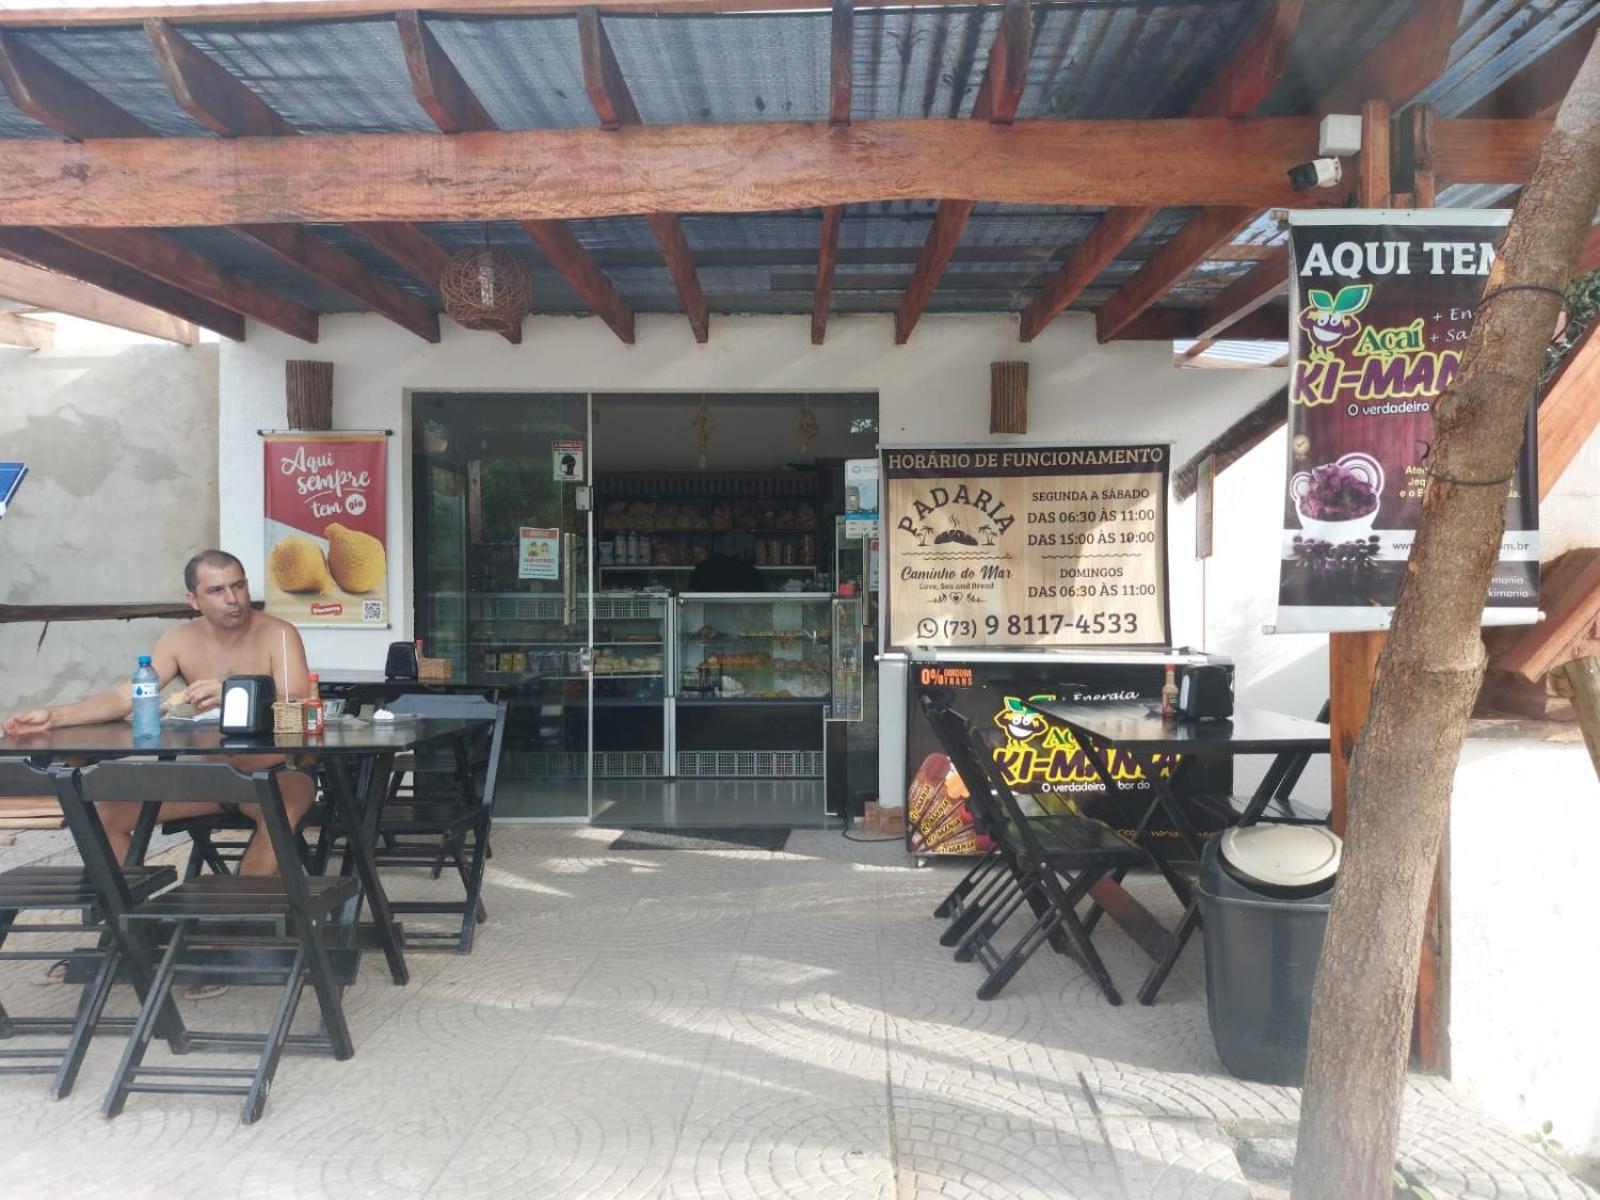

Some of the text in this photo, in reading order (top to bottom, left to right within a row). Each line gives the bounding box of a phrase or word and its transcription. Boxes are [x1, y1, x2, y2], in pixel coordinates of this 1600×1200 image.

[1300, 241, 1411, 279] AQUI
[1352, 319, 1425, 356] Açaí
[1292, 350, 1464, 407] KI-MAN
[1347, 401, 1430, 416] O verdadeiro
[281, 446, 335, 475] Aqui
[888, 451, 970, 470] HORÁRIO
[974, 453, 998, 468] DE
[1002, 448, 1163, 467] FUNCIONAMENTO
[296, 469, 371, 497] sempre
[1032, 488, 1150, 502] SEGUNDA A SÁBADO
[310, 501, 342, 518] tem
[898, 484, 1015, 536] PADARIA
[1027, 507, 1155, 524] DAS 06:30 ÀS 11:00
[1028, 534, 1057, 546] DAS
[1060, 533, 1095, 545] 15:00
[1098, 529, 1117, 544] ÀS
[901, 564, 1013, 580] Caminho do Mar
[1060, 567, 1124, 578] DOMINGOS
[1028, 582, 1156, 598] DAS 06:30 ÀS 11:00
[943, 611, 1139, 639] (73) 9 8117-4533
[921, 668, 944, 686] 0%
[993, 748, 1182, 786] KI-MANA
[1041, 782, 1051, 793] O
[1053, 781, 1106, 792] verdadeiro
[1137, 780, 1151, 790] do
